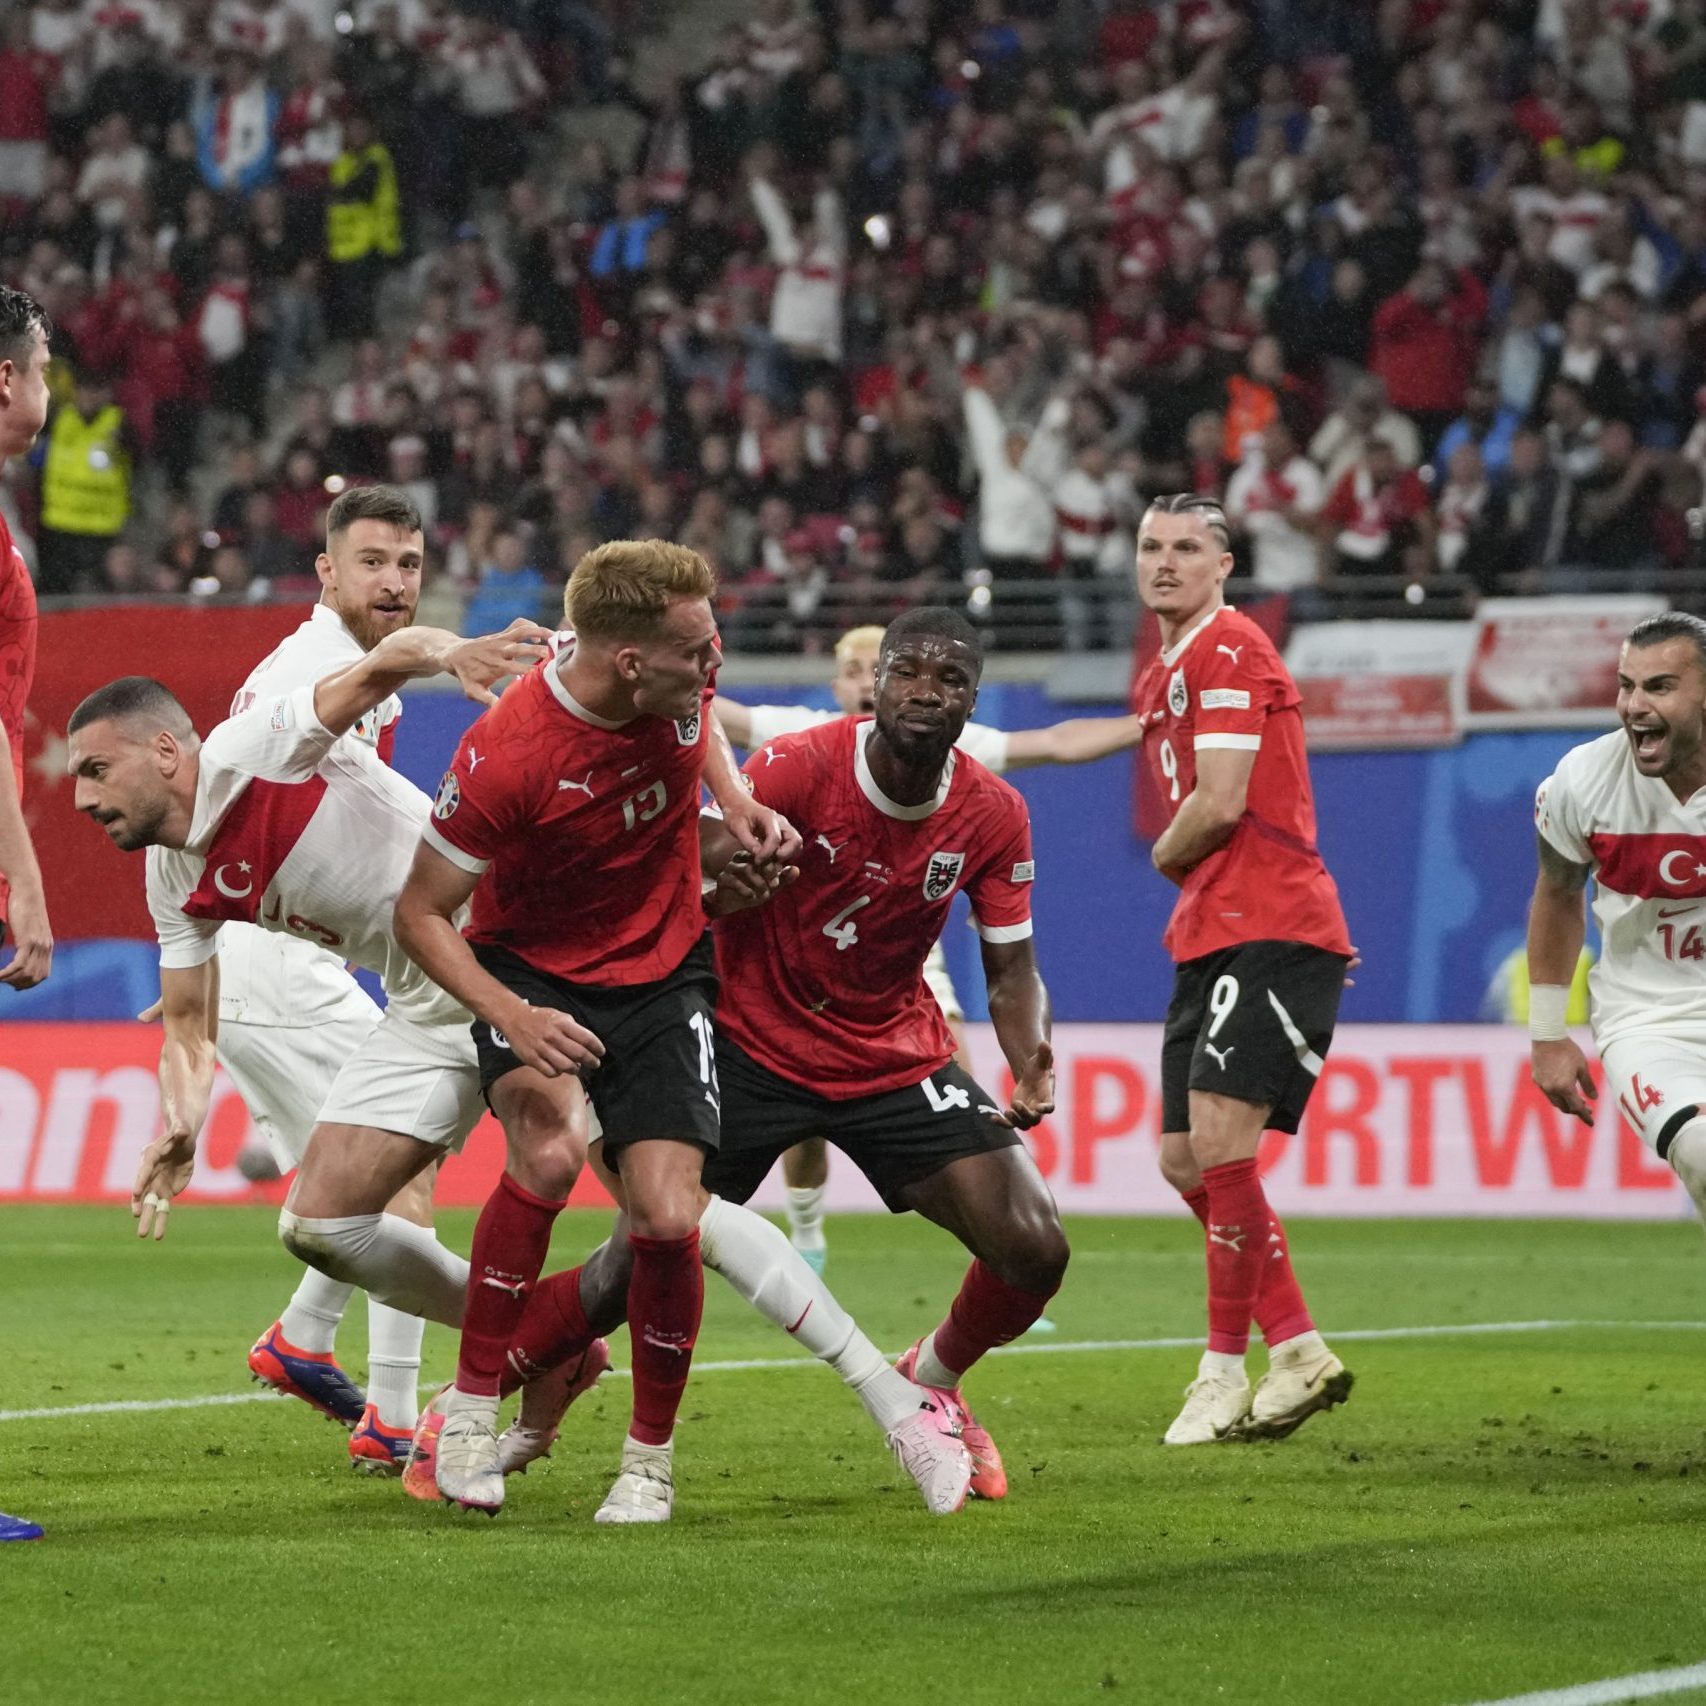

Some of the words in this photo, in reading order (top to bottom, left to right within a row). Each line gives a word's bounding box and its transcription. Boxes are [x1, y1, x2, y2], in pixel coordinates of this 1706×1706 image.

[1160, 738, 1180, 801] 9
[822, 895, 870, 950] 4
[1657, 924, 1706, 960] 14
[1208, 974, 1240, 1038] 9
[920, 1076, 970, 1112] 4
[1002, 1057, 1674, 1188] PRTW
[1620, 1072, 1665, 1132] 14
